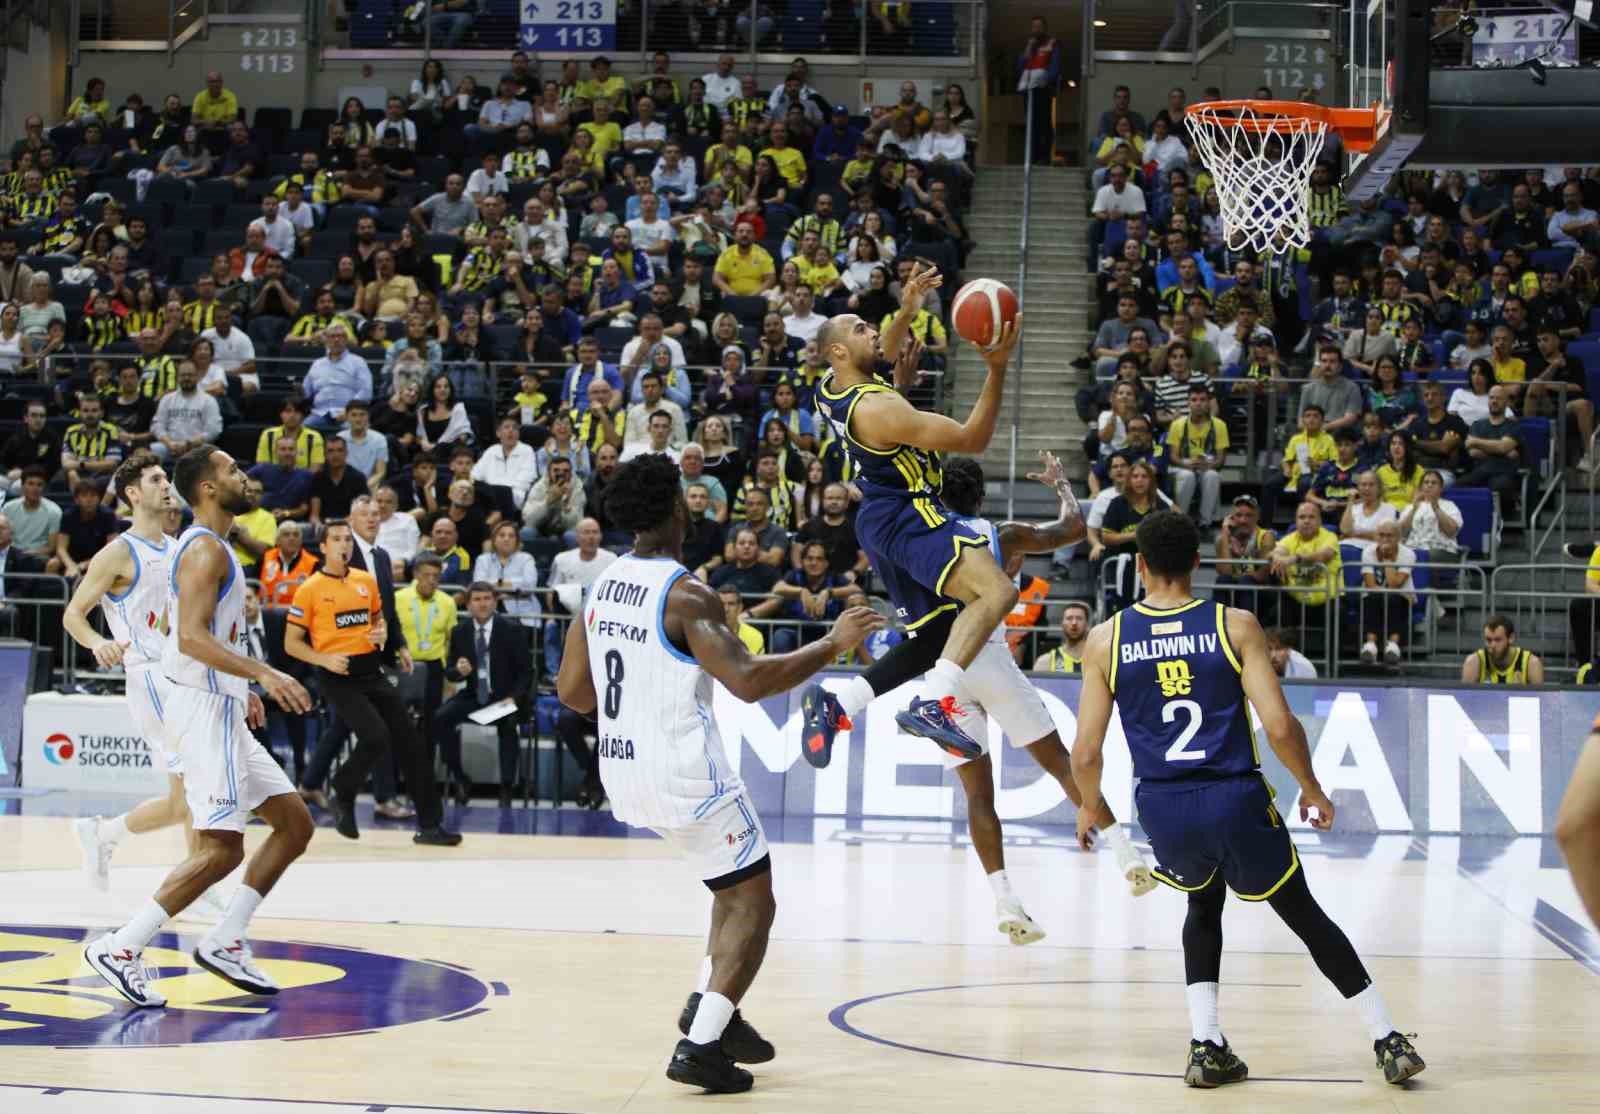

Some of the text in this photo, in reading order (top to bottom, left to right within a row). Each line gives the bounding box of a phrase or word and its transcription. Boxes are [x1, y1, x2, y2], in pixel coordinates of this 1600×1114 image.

[556, 1, 603, 20] 213
[256, 27, 297, 48] 213
[554, 27, 602, 47] 113
[1514, 18, 1565, 39] 212
[255, 53, 297, 73] 113
[1264, 44, 1308, 63] 212
[1264, 68, 1305, 88] 112
[1121, 632, 1217, 664] BALDWIN IV
[604, 648, 625, 720] 8
[1161, 699, 1207, 762] 2
